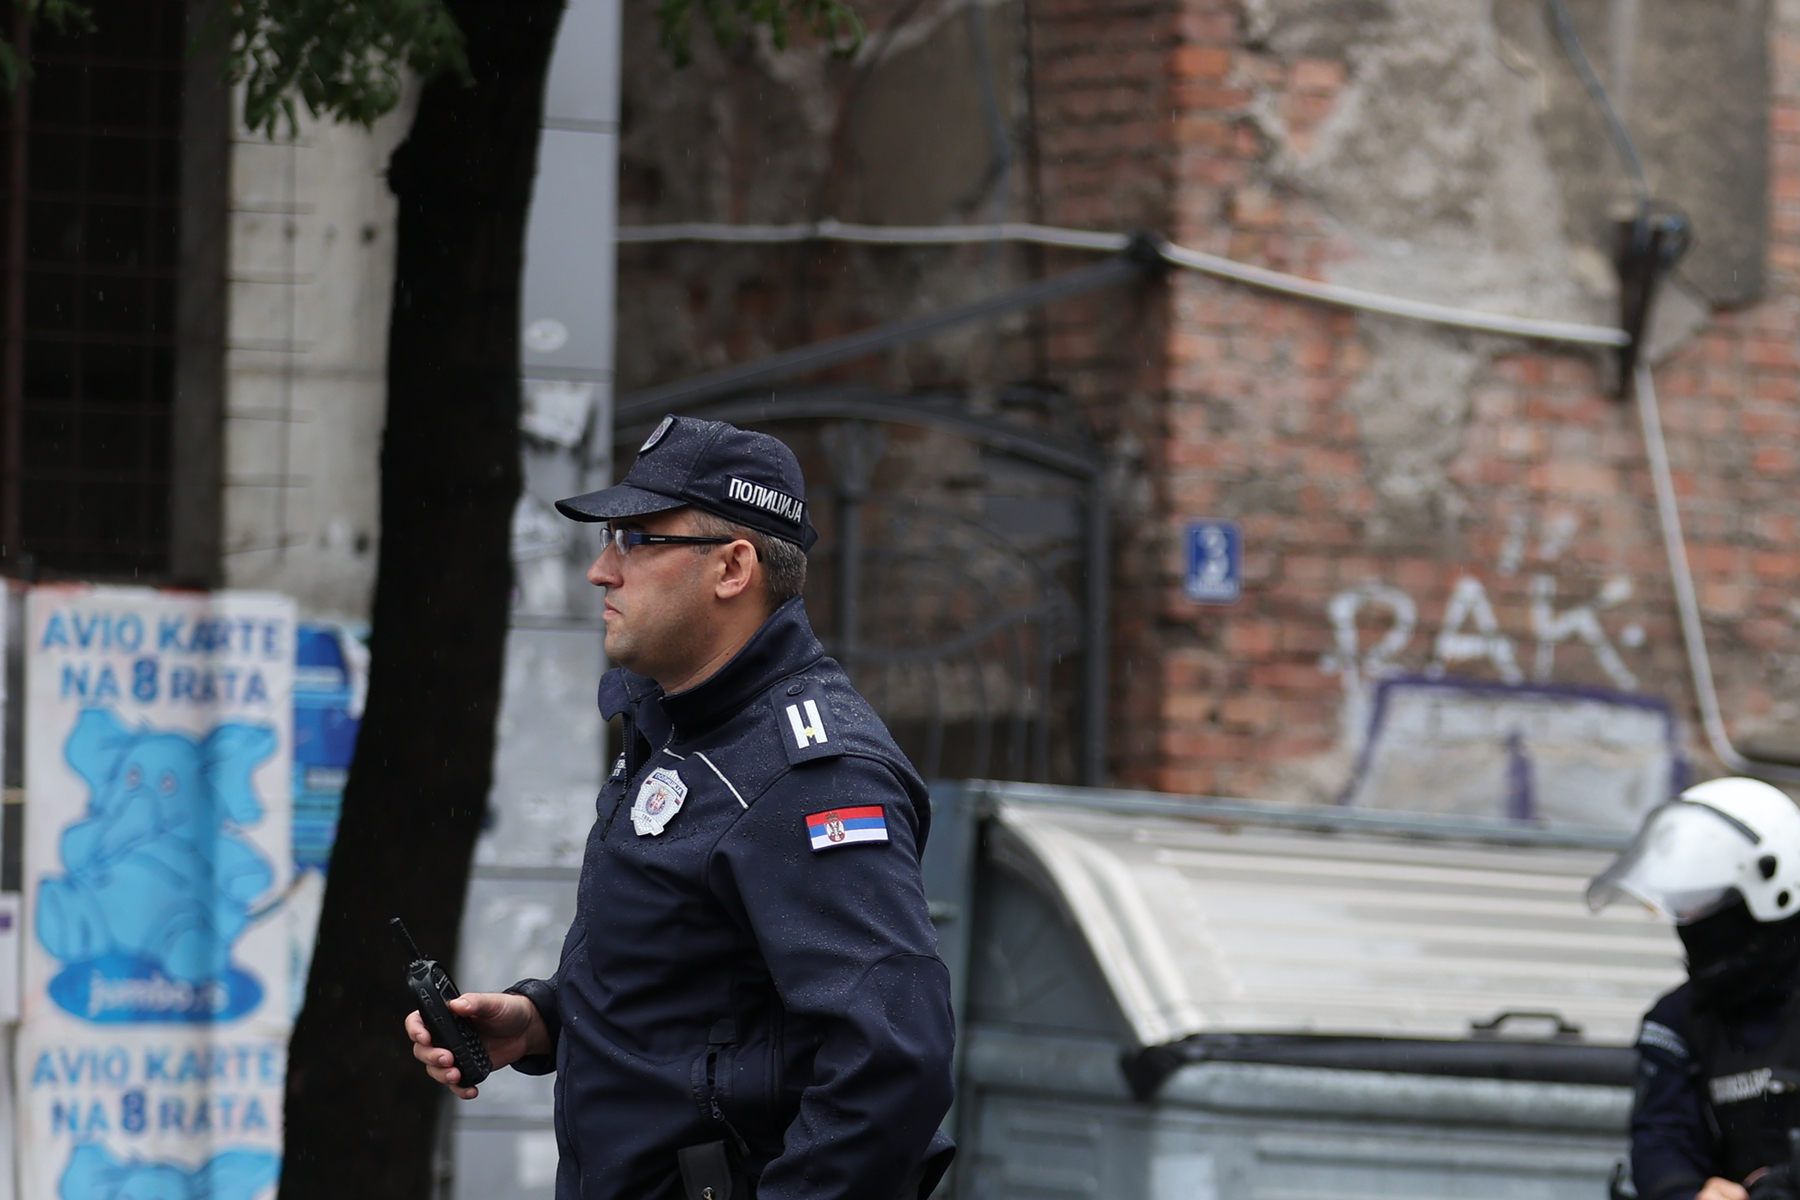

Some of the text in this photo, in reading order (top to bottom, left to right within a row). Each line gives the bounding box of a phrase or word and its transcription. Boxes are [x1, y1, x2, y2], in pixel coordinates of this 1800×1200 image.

[728, 478, 803, 522] ПОЛИЦИЈА
[42, 612, 282, 656] AVIO KARTE
[61, 664, 121, 698] NA
[132, 660, 158, 701] 8
[170, 668, 269, 702] RATA
[32, 1046, 281, 1088] AVIO KARTE
[52, 1090, 269, 1134] NA 8 RATA
